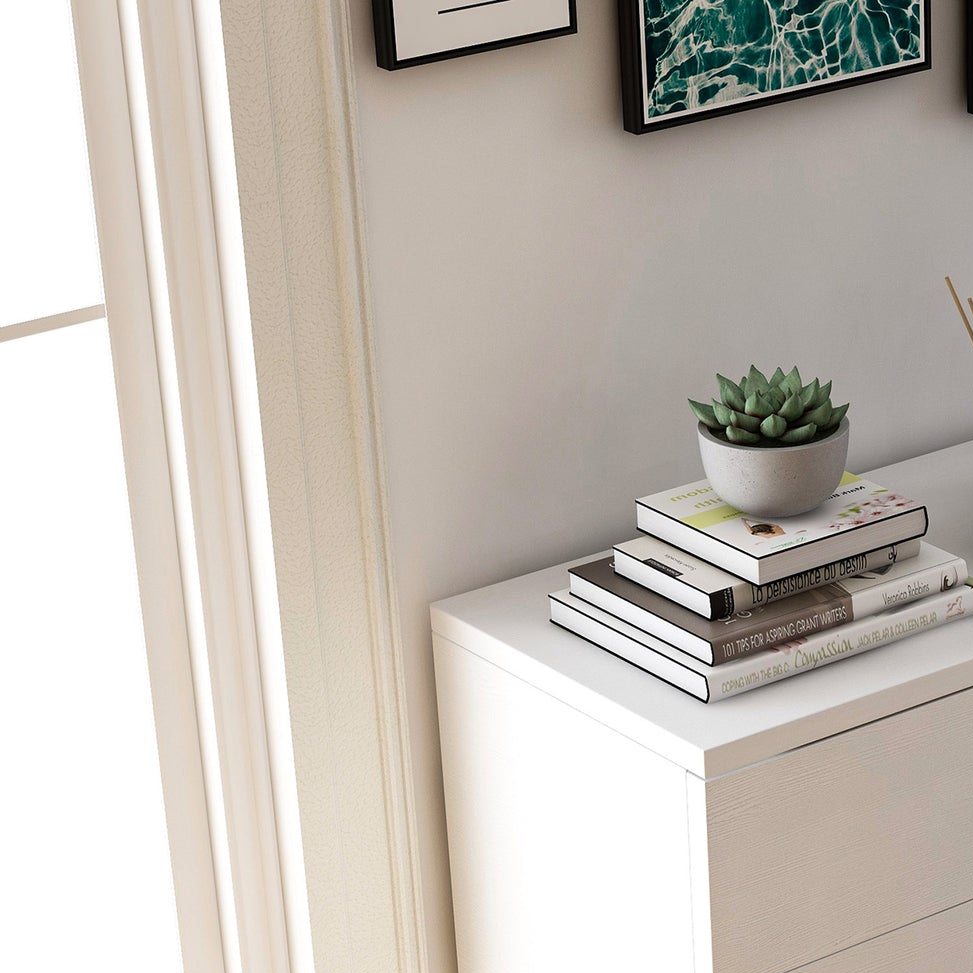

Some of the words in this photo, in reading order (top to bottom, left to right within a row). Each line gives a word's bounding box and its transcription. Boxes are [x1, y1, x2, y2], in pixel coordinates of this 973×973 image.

[908, 581, 930, 597] Robbins
[722, 642, 735, 658] 101
[736, 637, 751, 653] TIPS
[751, 633, 765, 649] FOR
[766, 622, 796, 643] ASPIRING
[796, 617, 819, 635] GRANT
[819, 606, 847, 625] WRITERS
[857, 634, 872, 649] JACK
[872, 628, 889, 643] PELAR
[889, 626, 895, 638] &
[895, 618, 920, 637] COLLEEN
[920, 612, 938, 627] PELAR
[721, 676, 745, 694] COPING
[745, 672, 760, 687] WITH
[760, 667, 773, 681] THE
[772, 664, 783, 679] BIG
